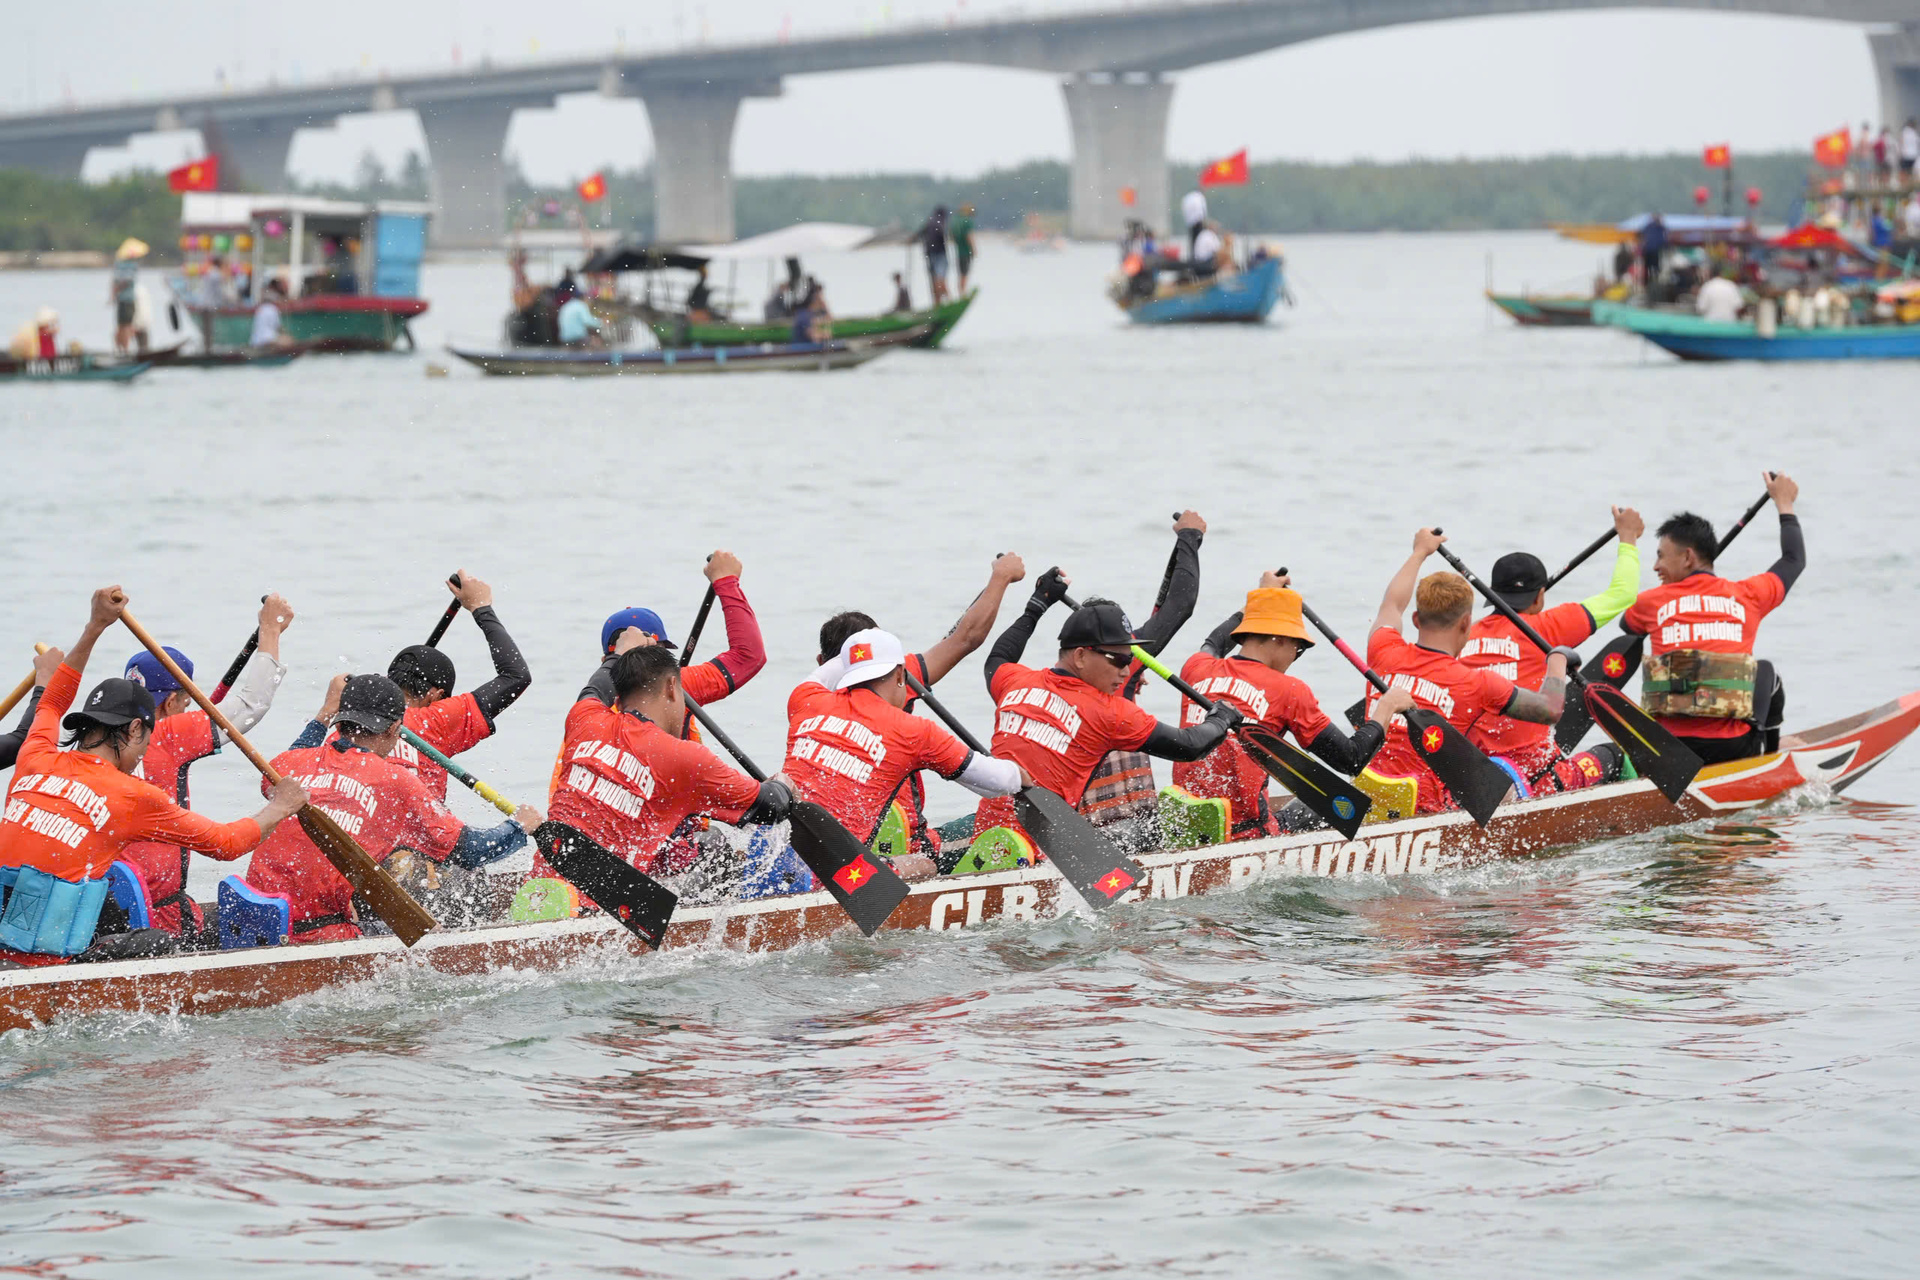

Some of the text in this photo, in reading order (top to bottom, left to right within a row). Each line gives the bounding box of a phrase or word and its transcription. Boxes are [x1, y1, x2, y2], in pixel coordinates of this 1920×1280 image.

[1657, 599, 1677, 627] CLB
[999, 687, 1029, 709] CLB
[795, 714, 826, 736] CLB
[572, 739, 603, 760] CLB
[10, 773, 44, 794] CLB
[929, 884, 1040, 933] CLB
